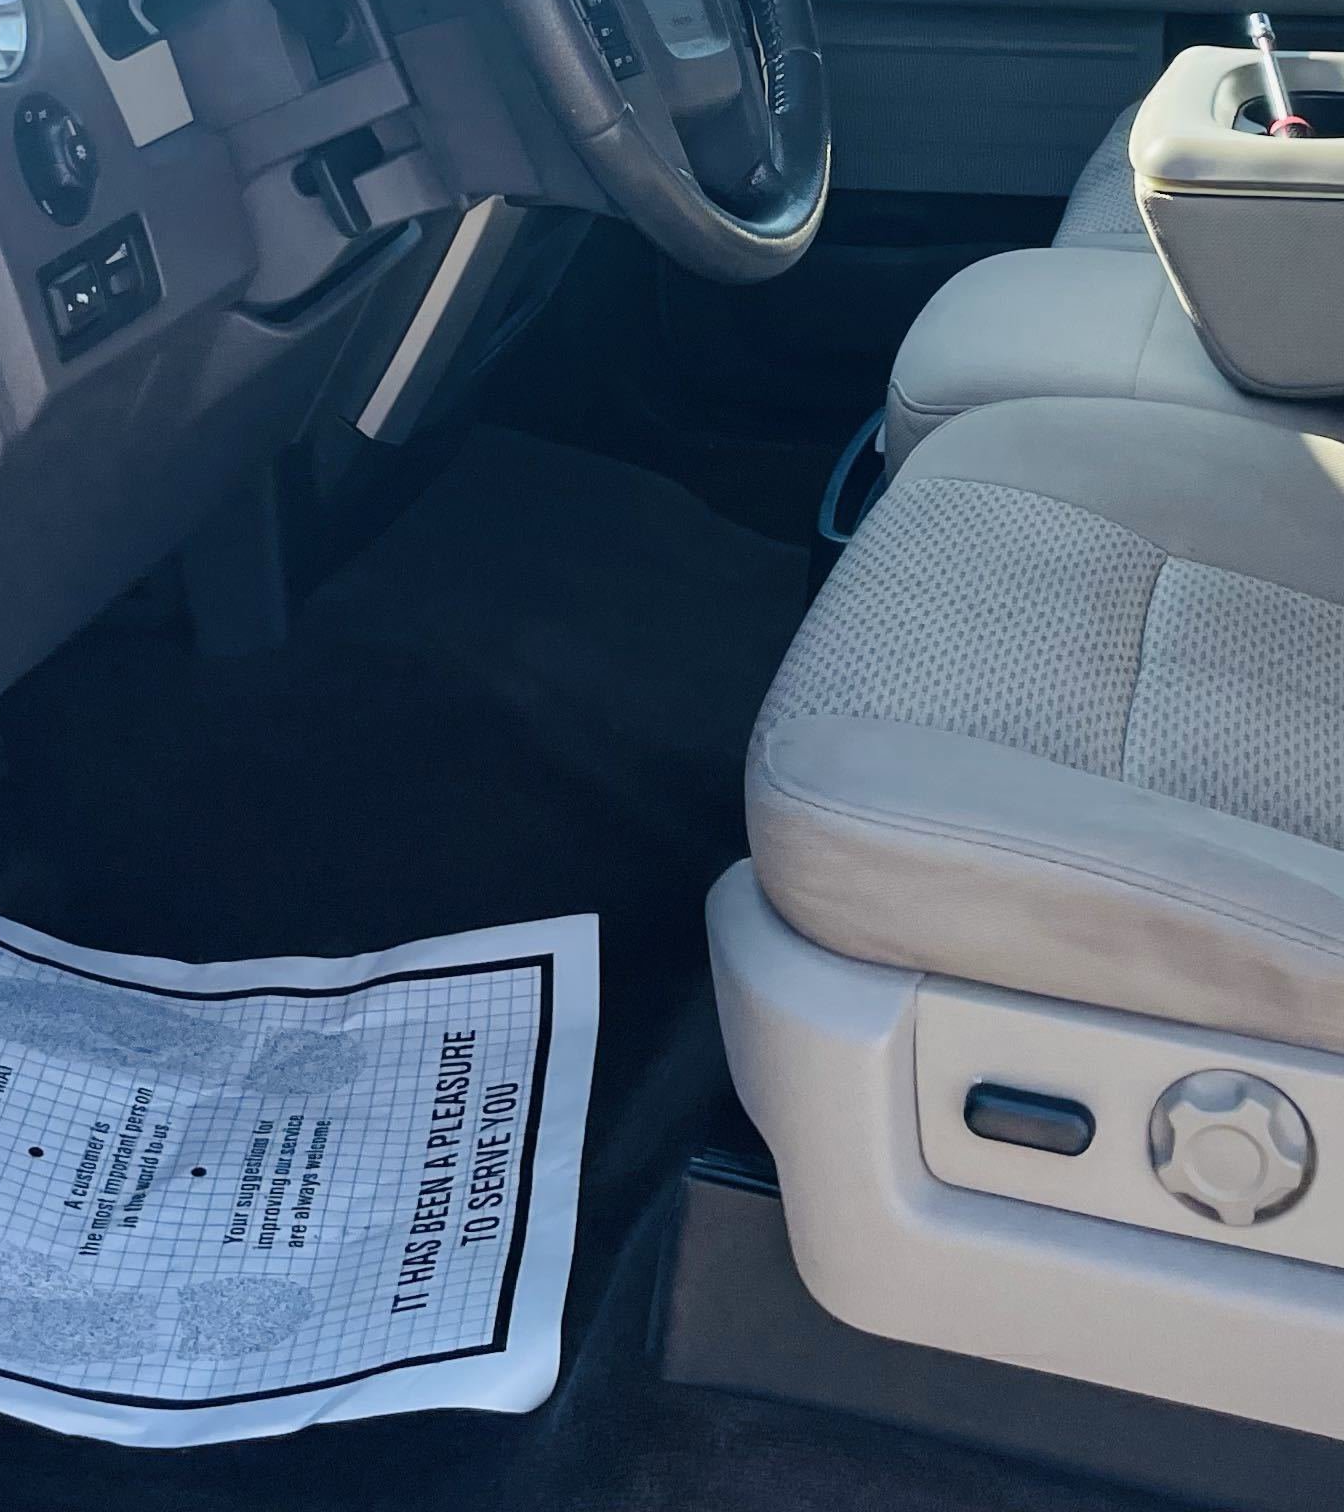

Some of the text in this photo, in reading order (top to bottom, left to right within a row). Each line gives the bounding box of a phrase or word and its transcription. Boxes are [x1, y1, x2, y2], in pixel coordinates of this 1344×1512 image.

[63, 1121, 111, 1210] A customer is
[78, 1087, 154, 1256] the most important person
[136, 1155, 160, 1192] world
[145, 1140, 164, 1155] to
[391, 1029, 476, 1314] IT HAS BEEN A PLEASURE
[461, 1082, 519, 1248] TO SERVE YOU
[124, 1189, 147, 1211] the
[223, 1212, 249, 1245] Your
[253, 1120, 275, 1134] for
[253, 1114, 305, 1250] improving our service
[291, 1173, 321, 1220] always
[117, 1215, 139, 1228] in
[288, 1224, 308, 1248] are
